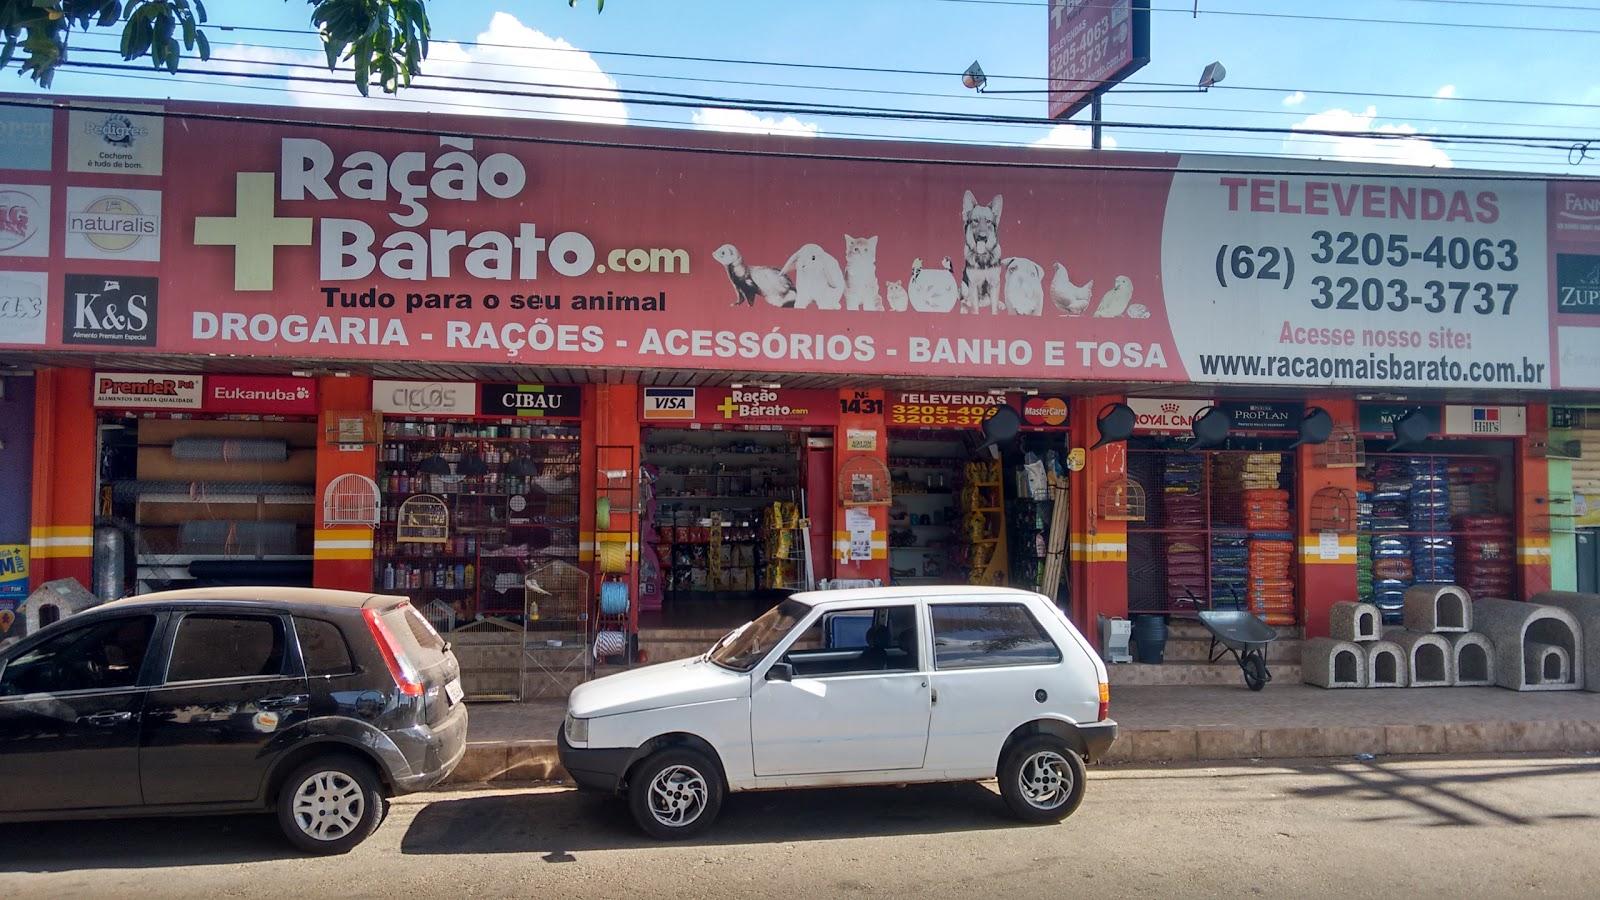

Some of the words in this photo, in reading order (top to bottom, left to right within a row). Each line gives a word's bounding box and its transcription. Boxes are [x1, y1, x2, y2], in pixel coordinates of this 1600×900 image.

[281, 136, 527, 227] Ração
[1220, 177, 1500, 223] TELEVENDAS
[72, 217, 155, 233] naturalis
[1311, 230, 1519, 272] 3205-4063
[1215, 244, 1296, 289] (62)
[321, 287, 395, 309] Tudo
[406, 290, 472, 313] para
[482, 293, 500, 310] o
[509, 292, 561, 311] seu
[571, 291, 666, 312] animal
[1311, 276, 1519, 315] 3203-3737
[1561, 286, 1600, 306] ZUP
[73, 292, 149, 332] K&S
[99, 333, 124, 341] Premium
[192, 311, 409, 346] DROGARIA
[446, 318, 604, 356] RAÇÕES
[638, 326, 875, 361] ACESSÓRIOS
[908, 336, 1033, 366] BANHO
[1044, 340, 1065, 366] E
[1076, 341, 1168, 369] TOSA
[1279, 321, 1355, 345] Acesse
[1362, 328, 1422, 349] nosso
[1428, 326, 1472, 350] site:
[1200, 352, 1546, 384] www.racaomaisbarato.com.br
[214, 386, 296, 401] Eukanuba
[502, 393, 562, 409] CIBAU
[732, 389, 777, 405] Ração
[901, 393, 1007, 405] TELEVENDAS
[654, 398, 687, 409] VISA
[840, 399, 883, 415] 1431
[892, 405, 999, 416] 3205-406
[892, 415, 991, 425] 3203-37
[1024, 407, 1067, 417] MasterCard
[1473, 420, 1499, 433] Hill's
